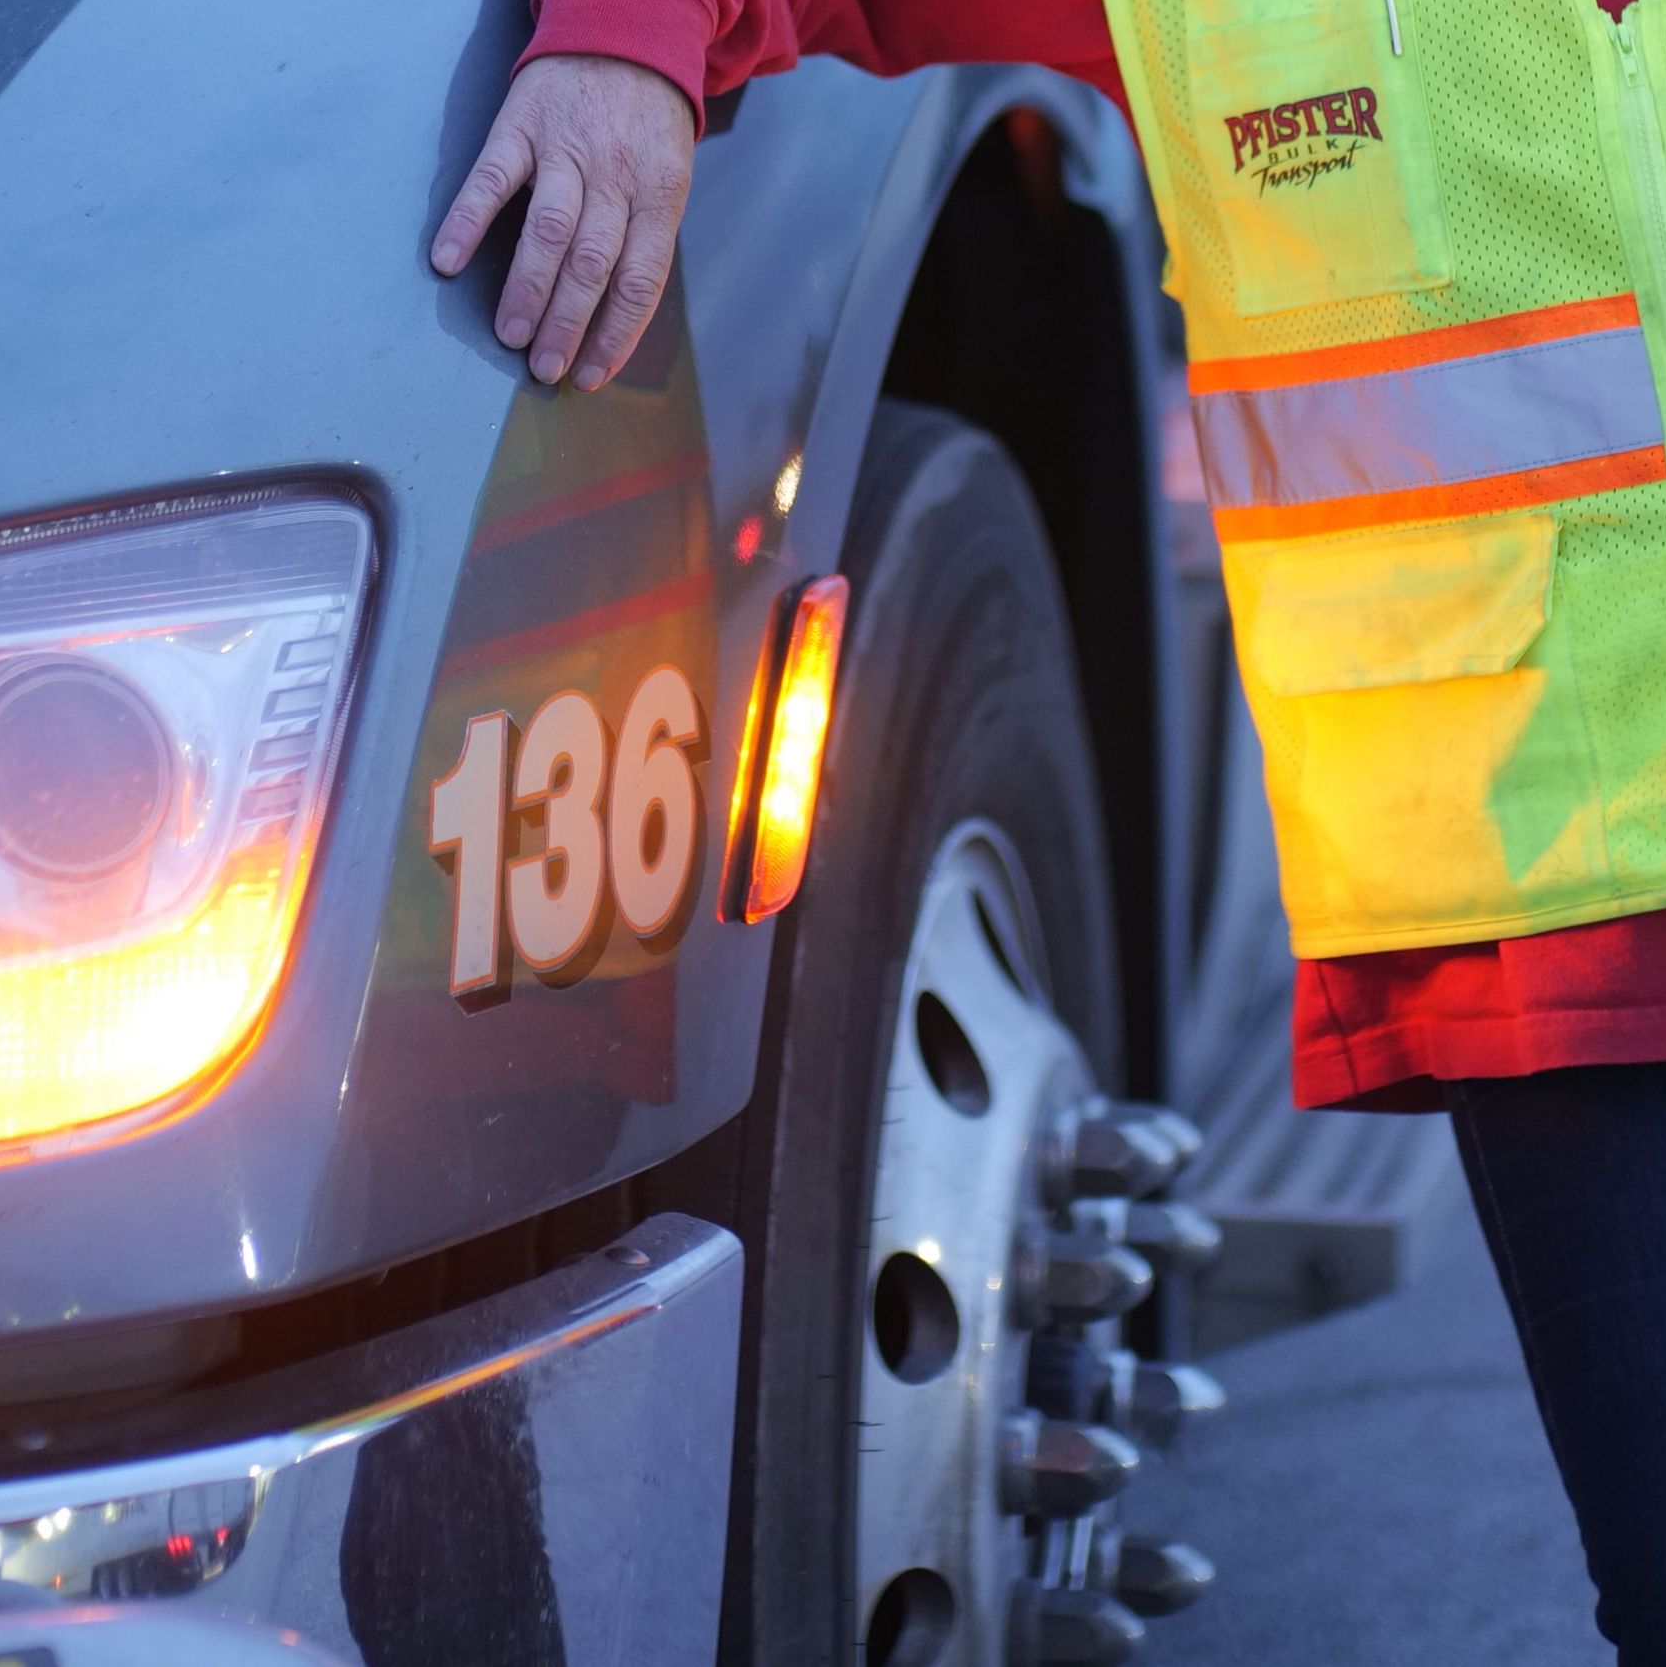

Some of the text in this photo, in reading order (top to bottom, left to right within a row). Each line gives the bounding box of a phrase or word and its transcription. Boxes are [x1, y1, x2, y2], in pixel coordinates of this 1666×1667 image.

[1224, 86, 1383, 175] PFISTER
[1268, 138, 1339, 165] BULK
[1251, 139, 1366, 199] Transport
[429, 663, 711, 1017] 136
